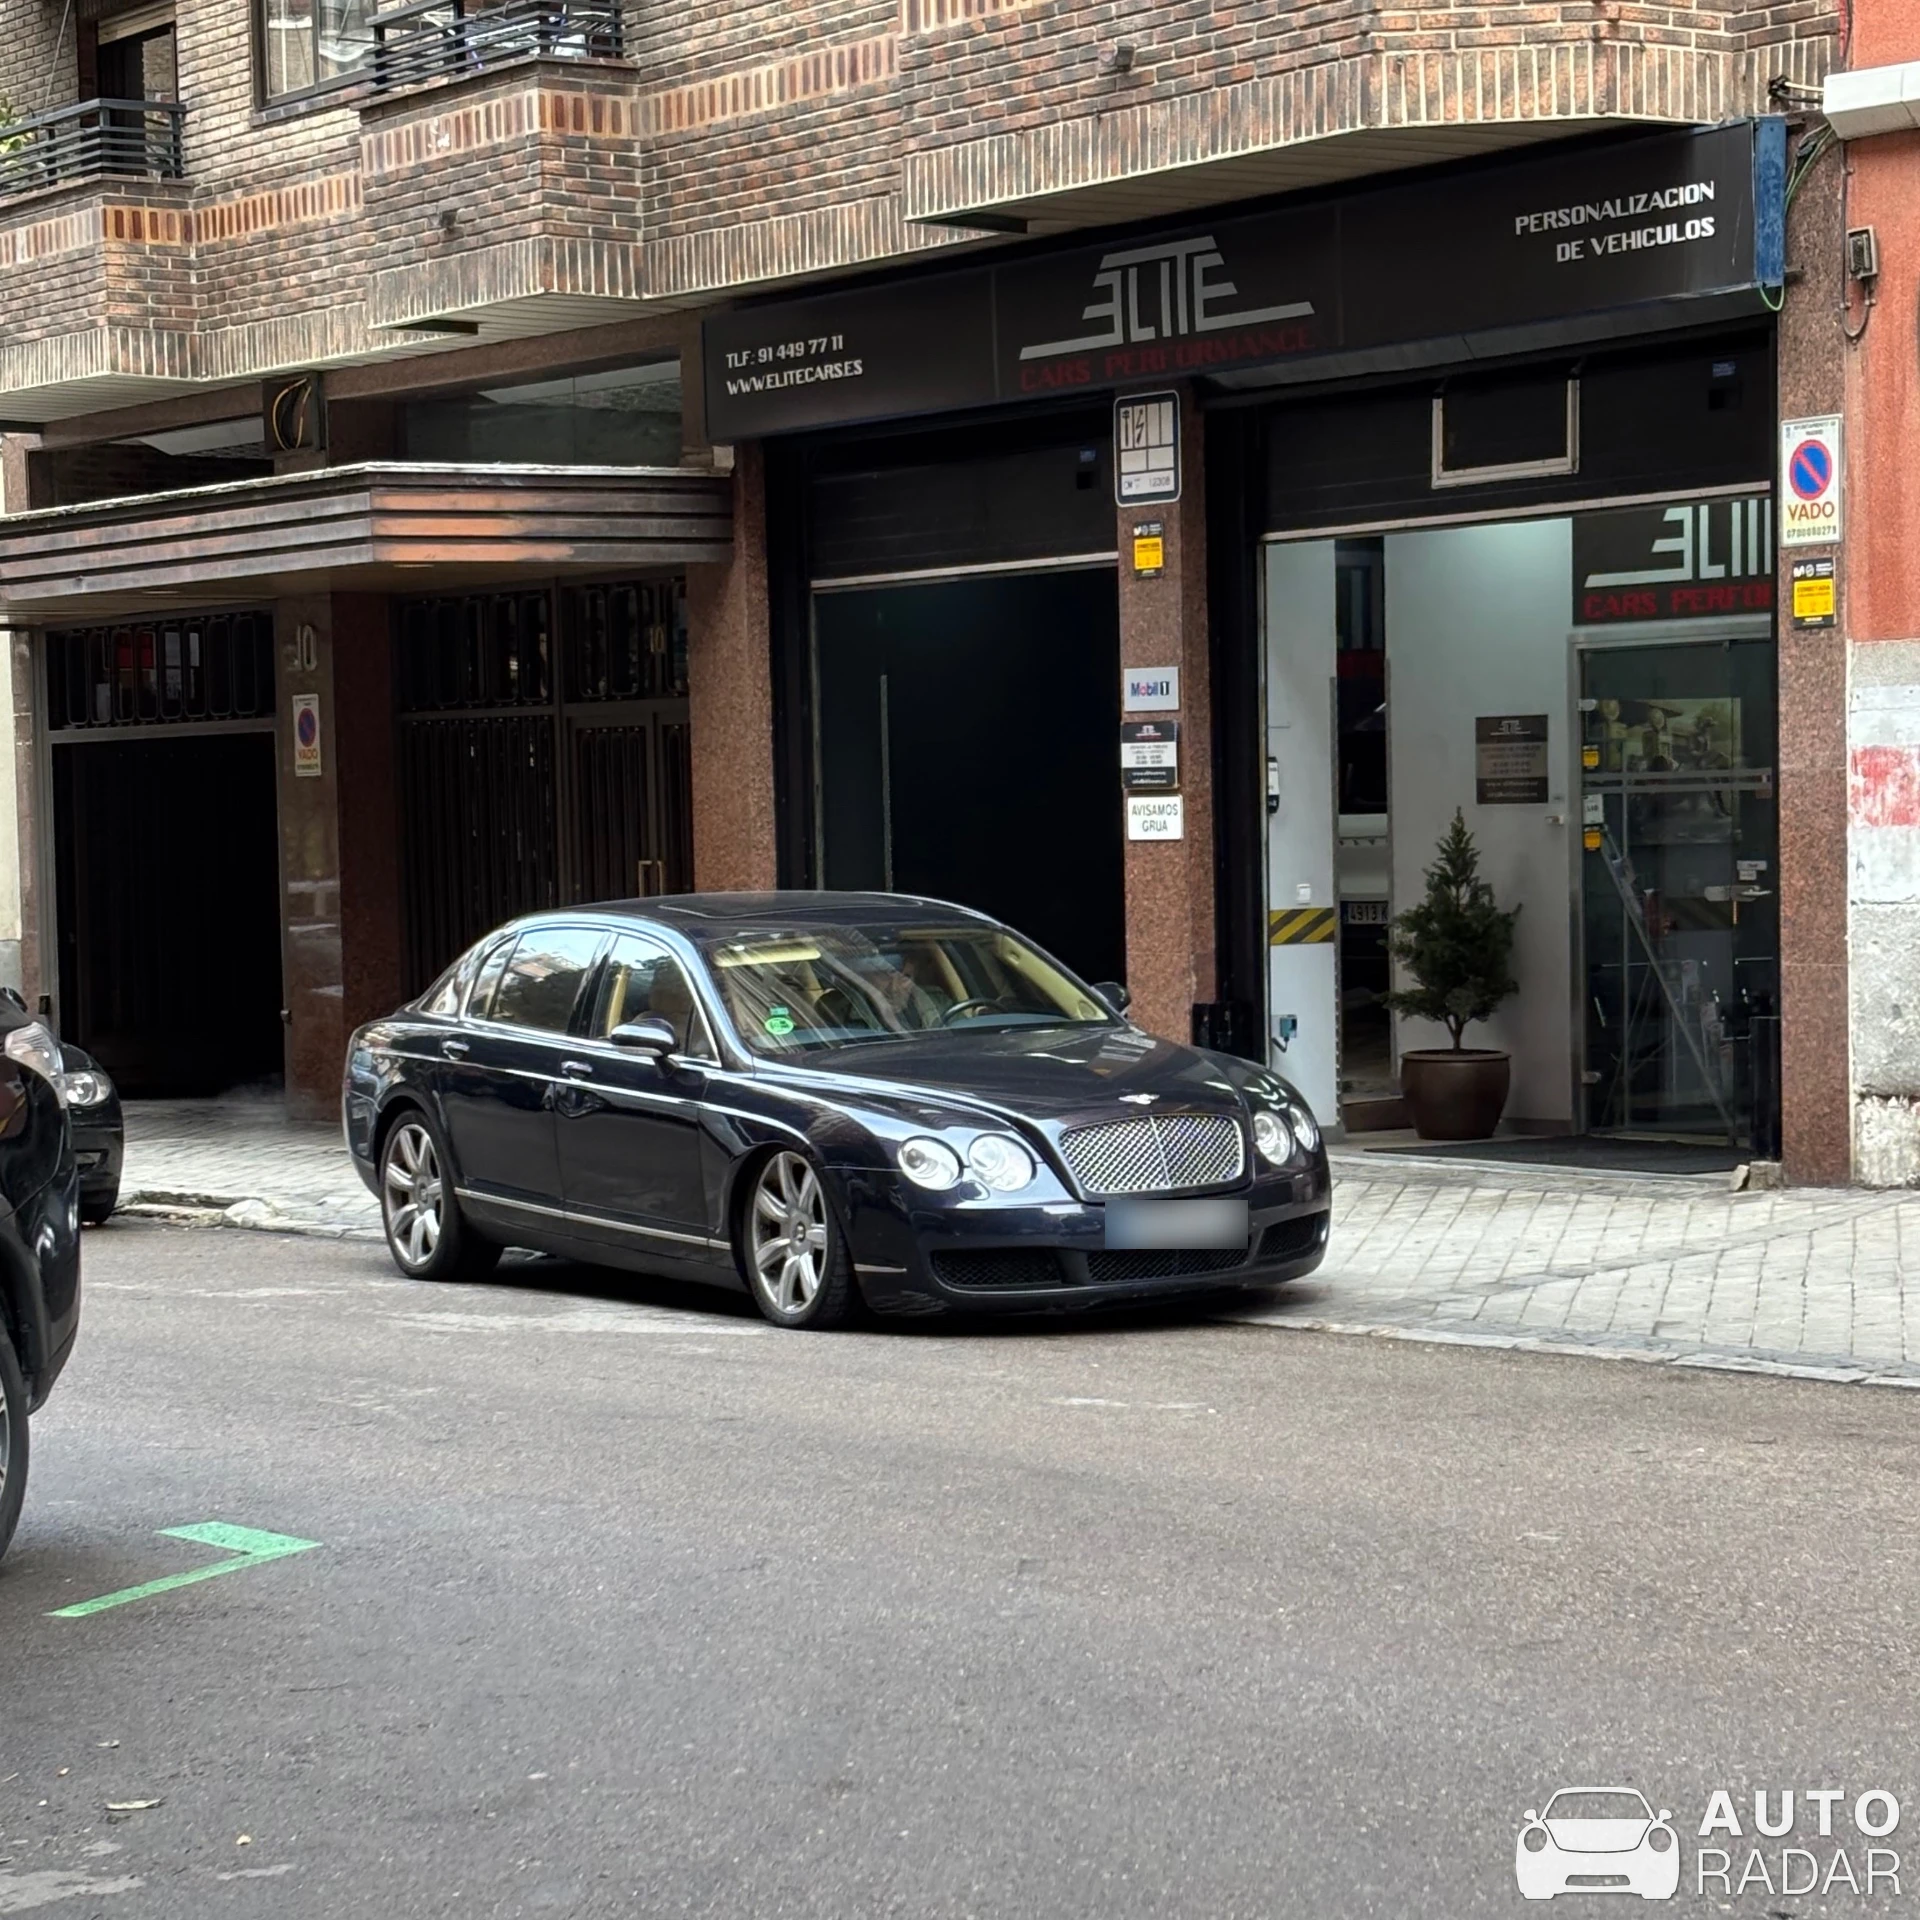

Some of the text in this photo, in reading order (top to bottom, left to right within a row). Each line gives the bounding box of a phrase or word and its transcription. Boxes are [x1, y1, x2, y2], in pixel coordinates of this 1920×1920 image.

[1515, 180, 1715, 235] PERSONALIZACION
[1556, 217, 1715, 262] DE VEHICULOS
[1019, 235, 1315, 361] ELITE
[726, 335, 844, 369] TLF: 91 449 77 11
[1020, 326, 1316, 392] CARS PERFORMANCE
[1787, 501, 1835, 521] VADO
[1584, 591, 1656, 619] CARS
[1131, 681, 1170, 697] Mobil 1
[1131, 803, 1178, 817] AVISAMOS
[1141, 819, 1168, 833] GRUA
